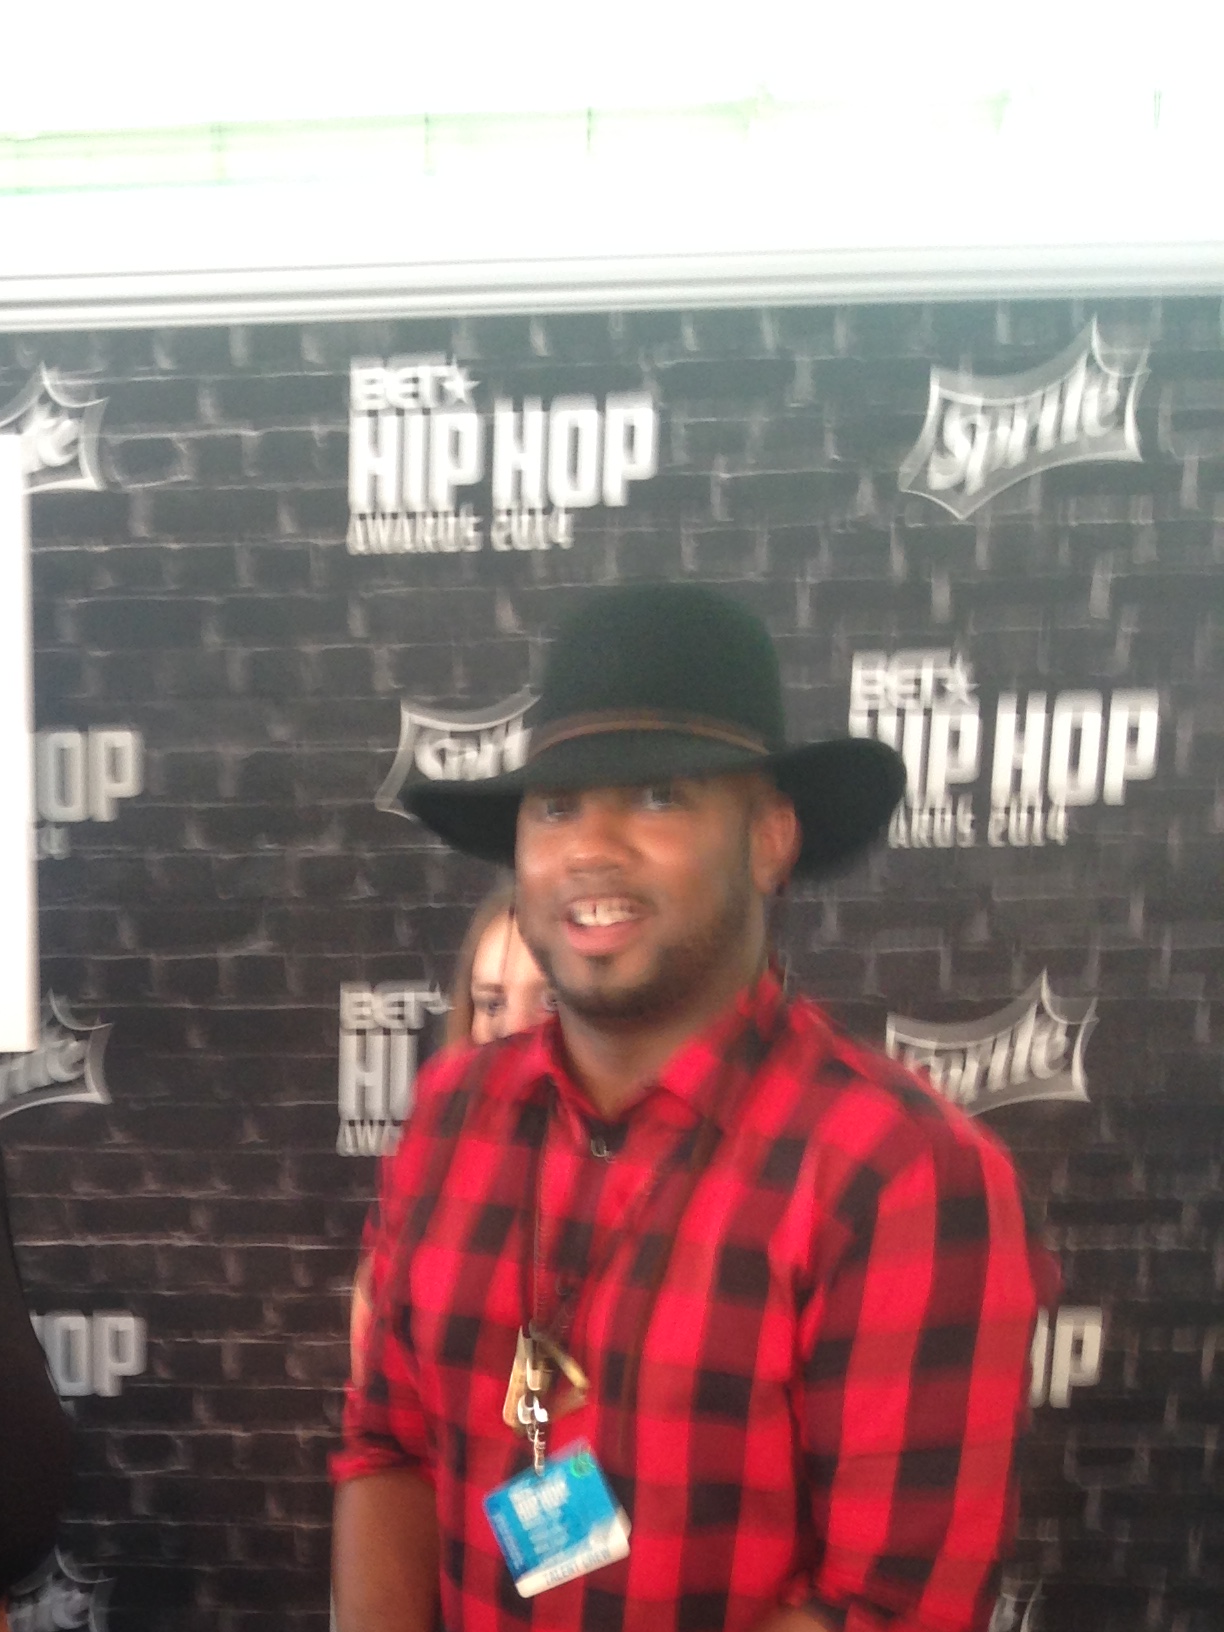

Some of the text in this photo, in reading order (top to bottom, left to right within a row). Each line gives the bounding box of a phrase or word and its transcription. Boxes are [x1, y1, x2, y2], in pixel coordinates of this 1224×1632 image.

[350, 357, 454, 411] BET
[928, 350, 1121, 496] Sprite
[349, 393, 660, 514] HIP HOP
[851, 650, 953, 711] BET
[990, 687, 1160, 806] HOP
[340, 980, 437, 1031] BET
